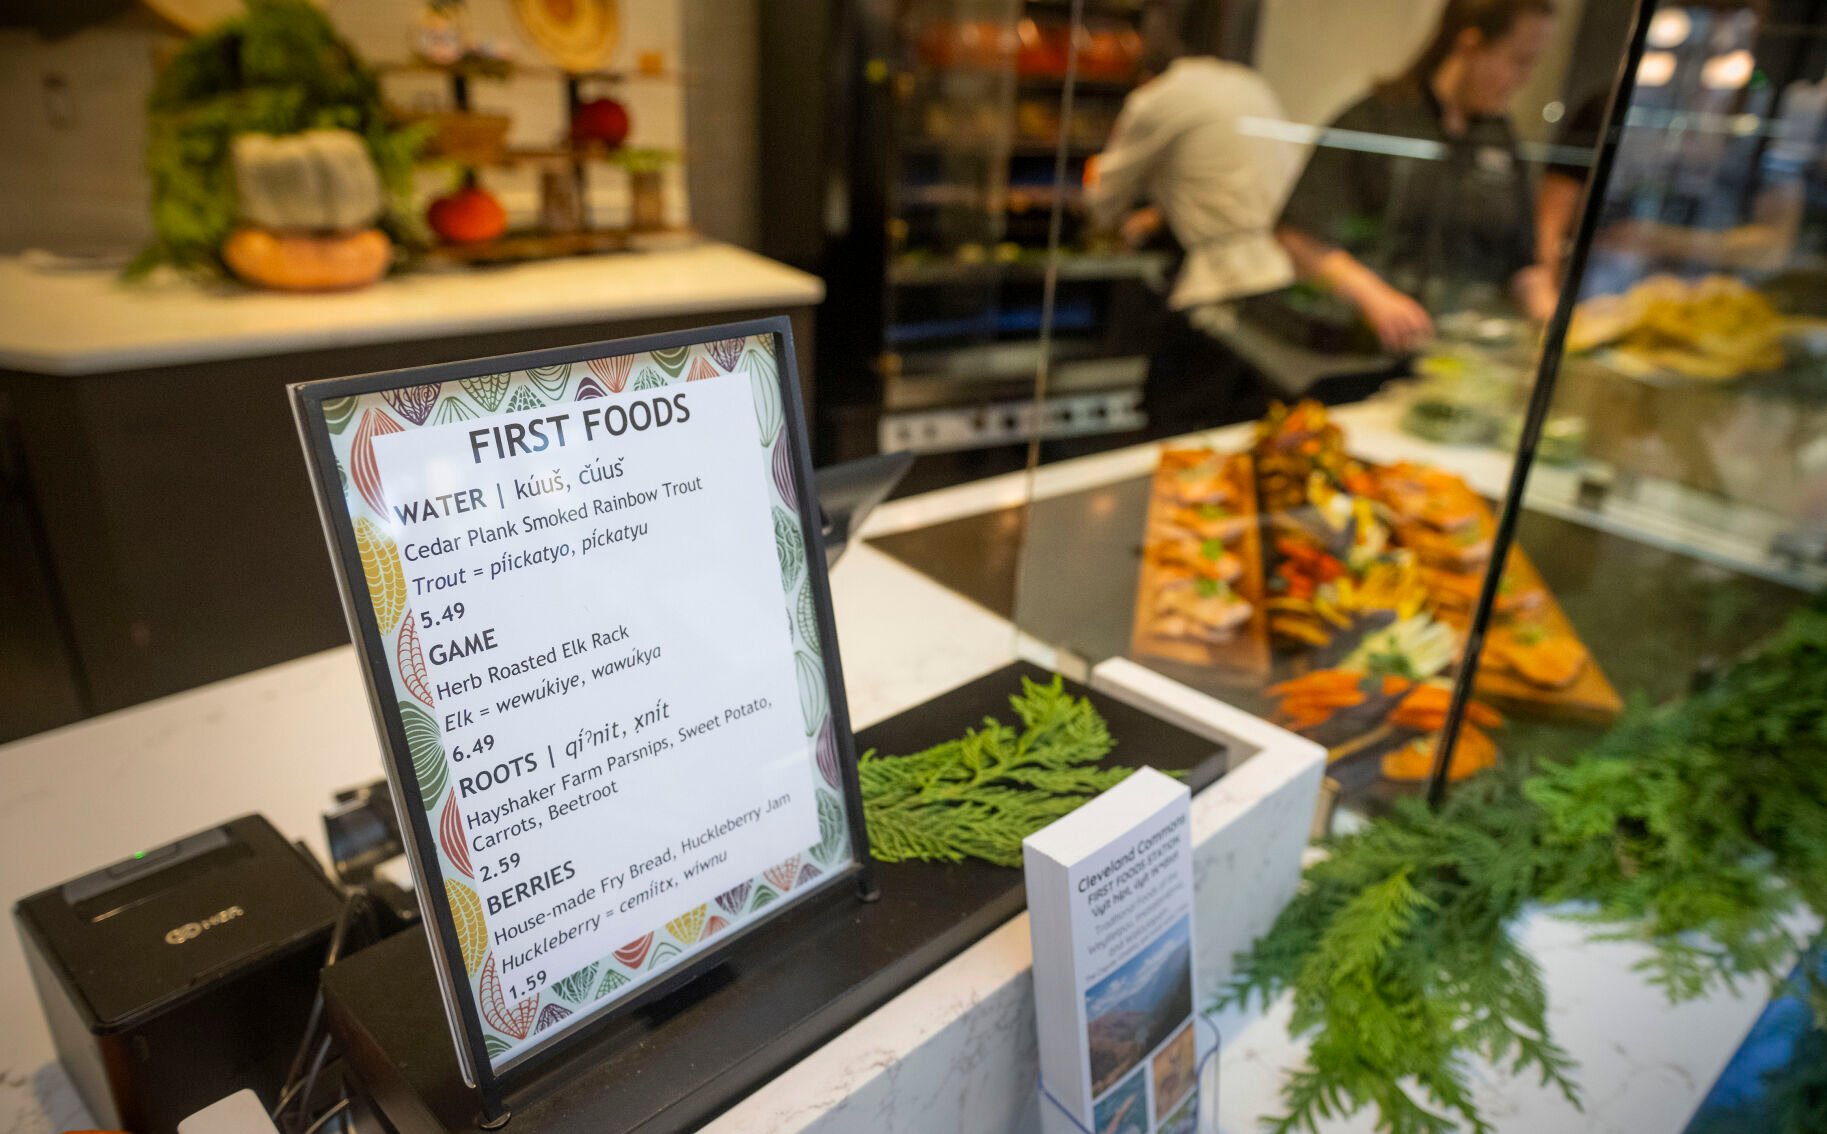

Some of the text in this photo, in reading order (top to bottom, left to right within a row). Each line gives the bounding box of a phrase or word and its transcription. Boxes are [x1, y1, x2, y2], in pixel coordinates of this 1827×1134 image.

[468, 392, 691, 465] FIRST FOODS
[394, 487, 488, 526] WATER
[403, 476, 704, 562] Cedar Plank Smoked Rainbow Trout
[411, 567, 467, 596] Trout
[419, 601, 466, 630] 5.49
[428, 627, 499, 666] GAME
[435, 624, 630, 701] Herb Roasted Elk Rack
[444, 708, 475, 733] Elk
[495, 674, 586, 715] wewúkiye,
[591, 645, 662, 681] wawúkya
[452, 734, 495, 763] 6.49
[458, 751, 538, 799] ROOTS
[466, 697, 772, 831] Hayshaker Farm Parsnips, Sweet Potato,
[472, 780, 619, 853] Carrots, Beetroot
[479, 852, 521, 884] 2.59
[493, 793, 791, 947] House-made Fry Bread, Huckleberry Jam
[1078, 846, 1135, 894] Cleveland
[1137, 813, 1185, 855] Commons
[1088, 880, 1113, 906] FIRST
[1116, 858, 1146, 887] FOODS
[486, 859, 576, 917] BERRIES
[501, 913, 601, 975] Huckleberry
[508, 969, 548, 1000] 1.59
